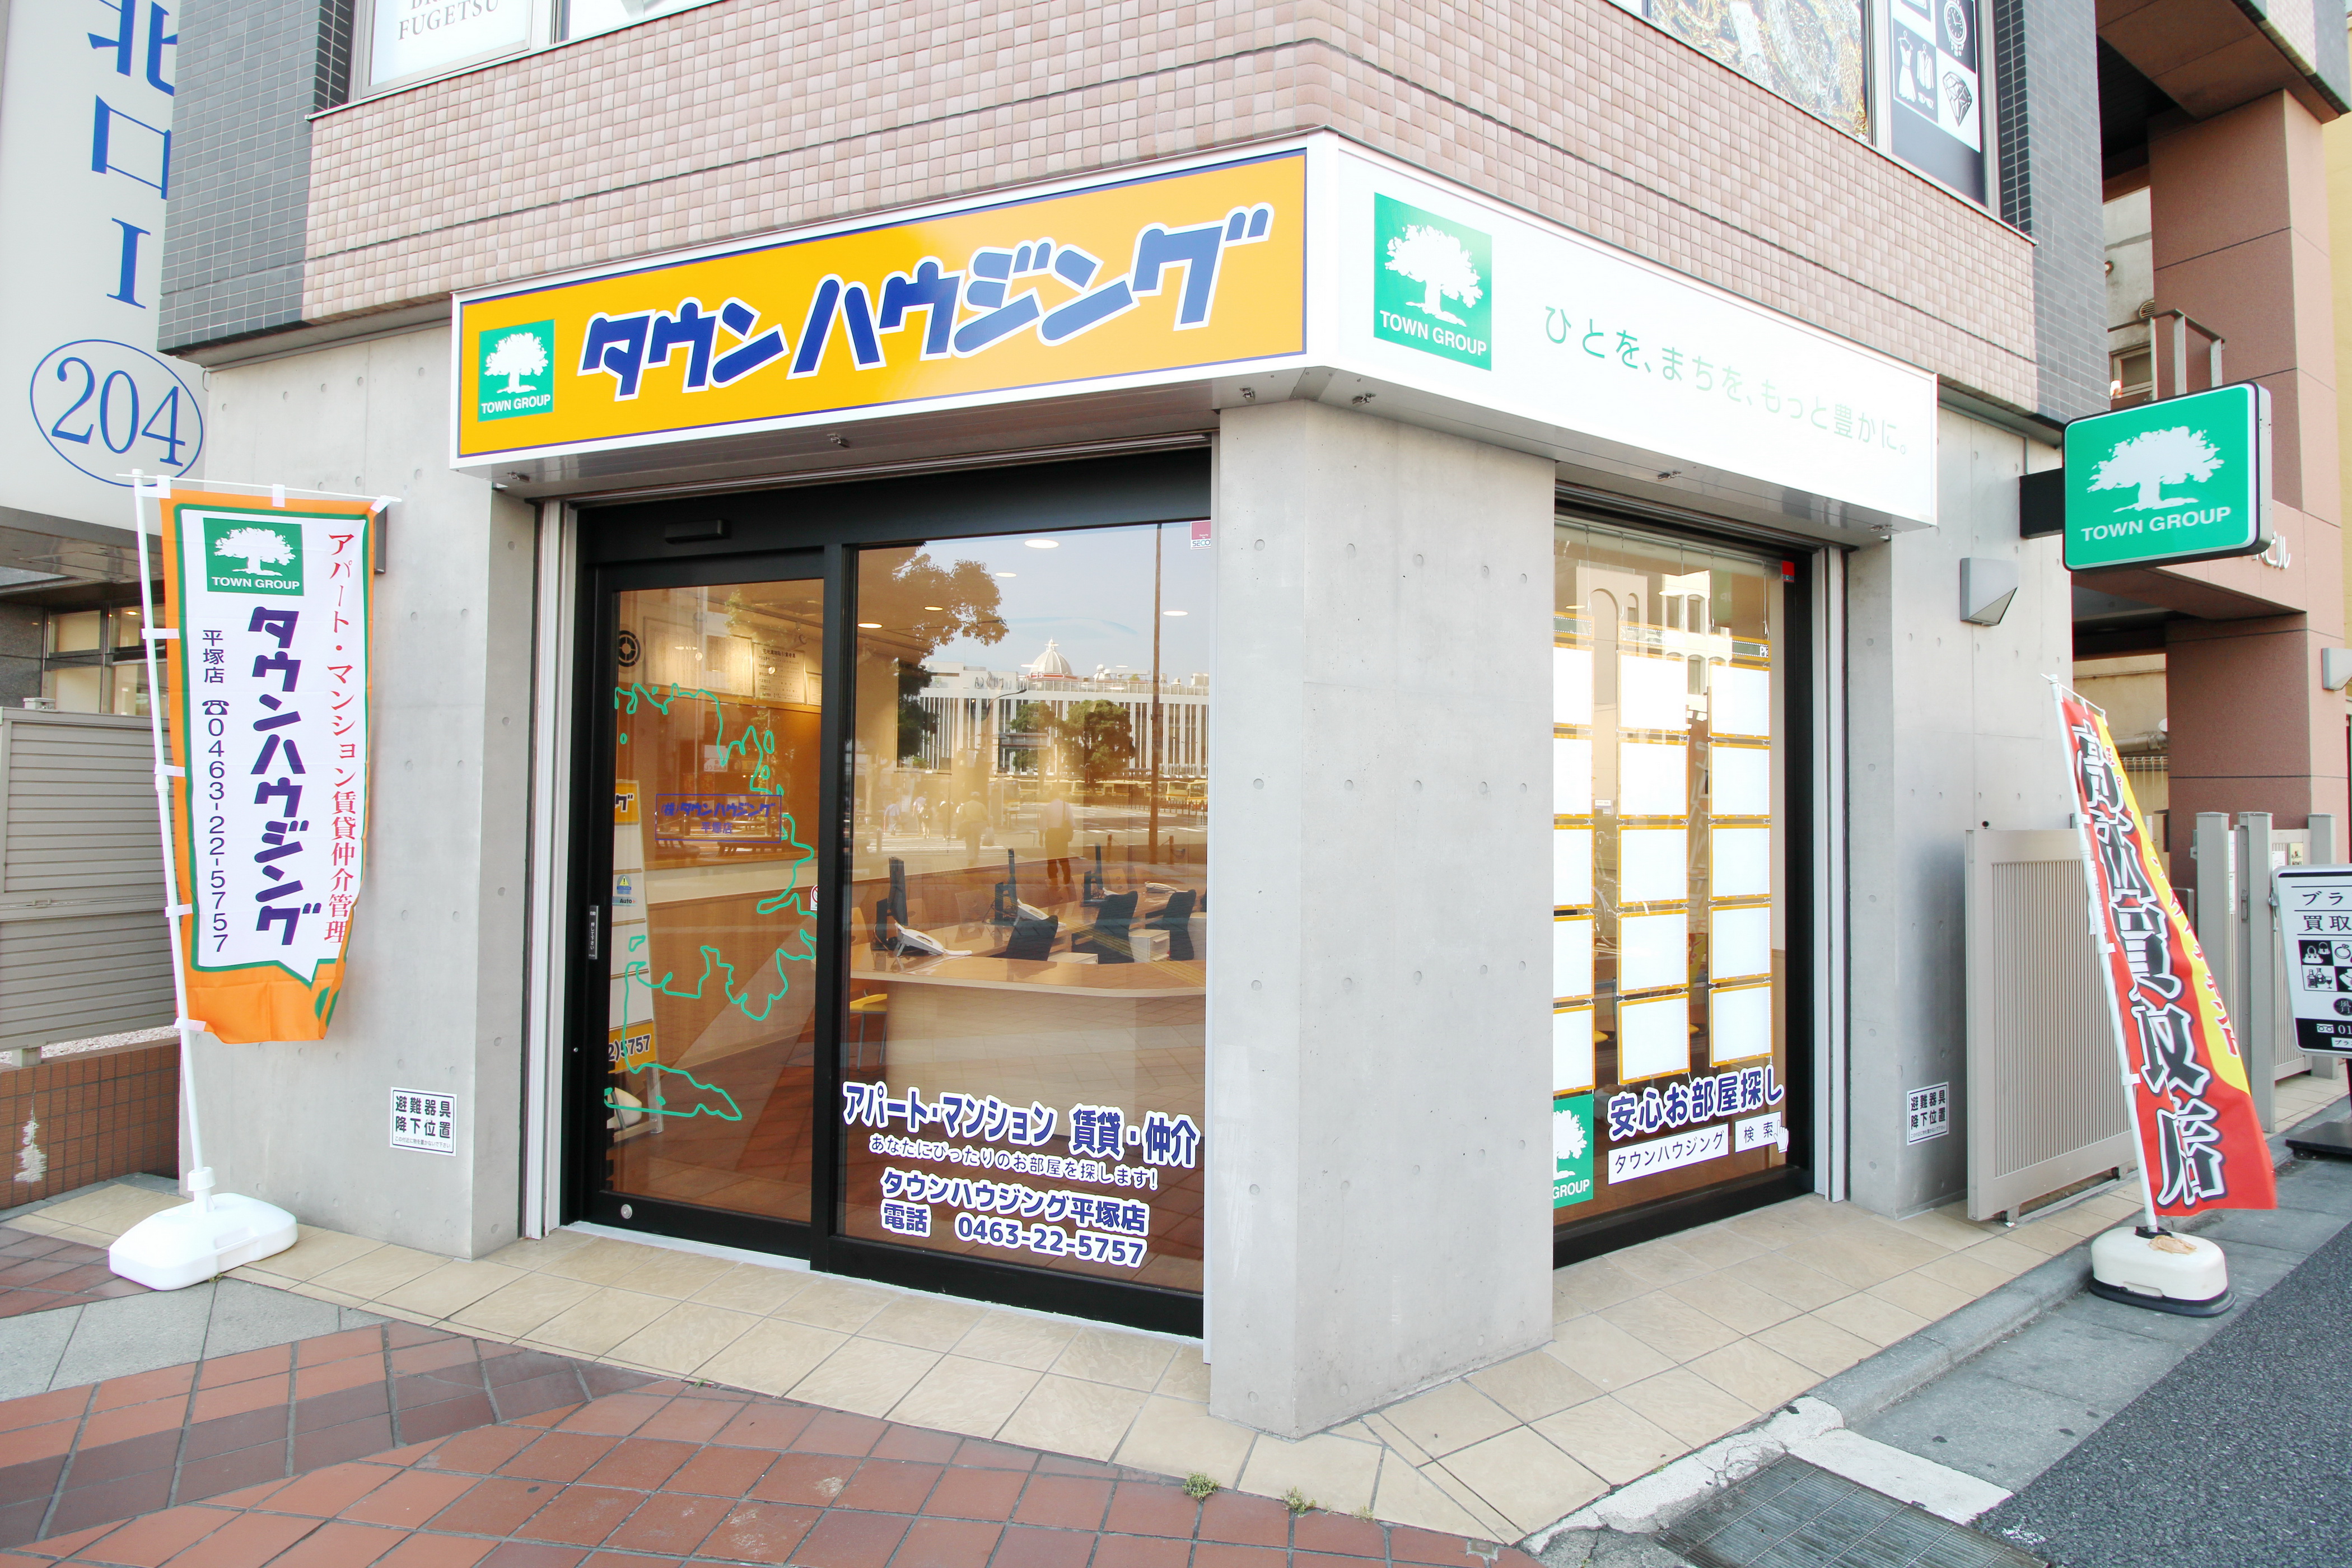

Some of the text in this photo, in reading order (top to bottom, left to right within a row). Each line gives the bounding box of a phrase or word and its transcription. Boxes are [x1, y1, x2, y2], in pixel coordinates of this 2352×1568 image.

[579, 204, 1272, 400] タウンハウジング
[1379, 310, 1487, 356] TOWN GROUP
[481, 394, 550, 414] TOWN GROUP
[1544, 305, 1906, 455] ひとを、まちを、もっと豊かに。
[52, 357, 186, 467] 204
[2080, 506, 2232, 541] TOWN GROUP
[212, 576, 300, 590] TOWN GROUP
[324, 533, 356, 944] アパート・マンション賃貸仲介管理
[202, 629, 228, 952] 平塚店 0463-22-5757
[248, 606, 321, 945] タウンハウジング
[2303, 915, 2352, 931] 買取
[395, 1095, 451, 1118] 避難器具
[395, 1116, 451, 1138] 降下位置
[844, 1082, 1200, 1167] アパート・マンション 賃貸・仲介
[1608, 1065, 1784, 1140] 安心お部屋探し
[1911, 1089, 1945, 1112] 避難器具
[1911, 1107, 1945, 1130] 降下位置
[870, 1134, 1158, 1189] あなたにぴったりのお部屋を探します!
[1615, 1121, 1773, 1174] タウンハウジング 検索
[881, 1168, 1149, 1236] タウンハウジング平塚店
[1553, 1179, 1590, 1199] GROUP
[883, 1200, 1146, 1267] 電話 0463-22-5757
